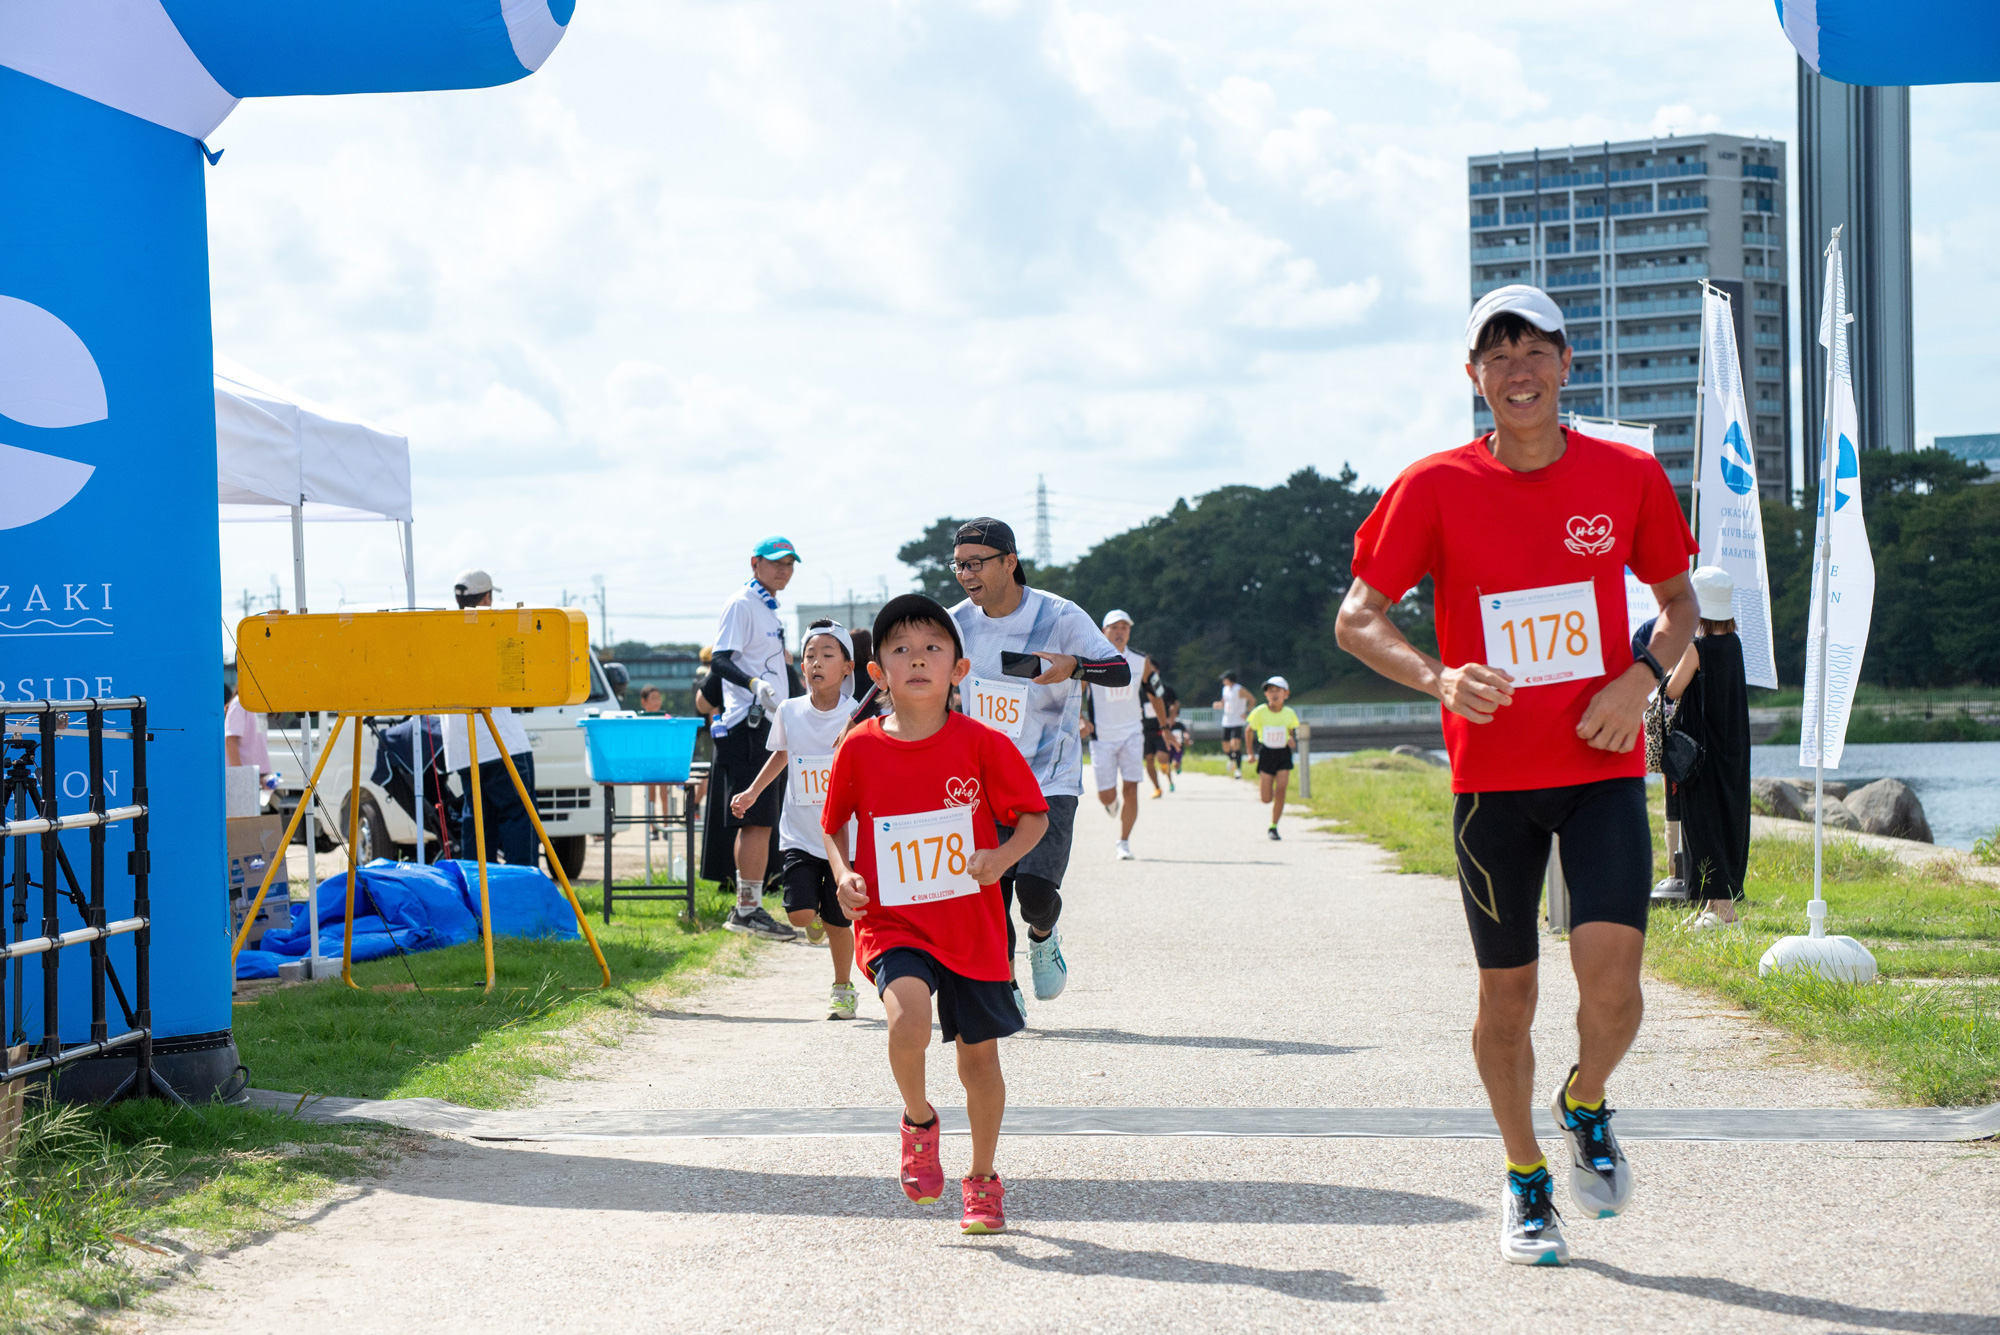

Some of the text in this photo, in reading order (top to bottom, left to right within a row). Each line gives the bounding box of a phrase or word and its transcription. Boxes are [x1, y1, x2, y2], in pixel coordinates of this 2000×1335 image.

[1501, 610, 1588, 665] 1178
[977, 693, 1020, 724] 1185
[890, 833, 967, 883] 1178
